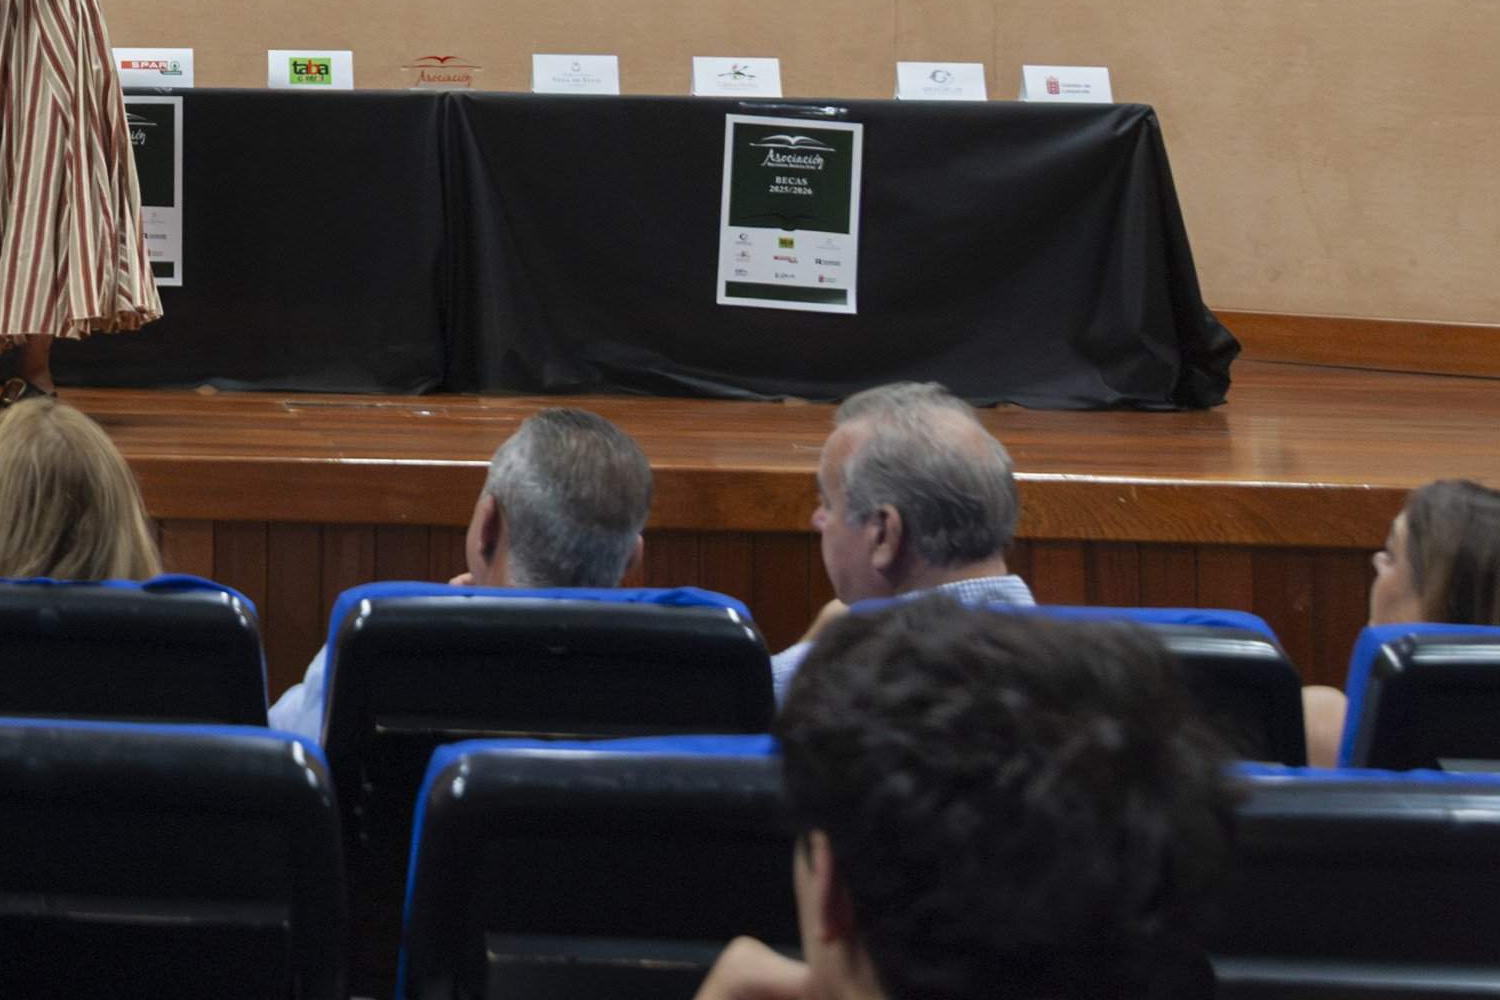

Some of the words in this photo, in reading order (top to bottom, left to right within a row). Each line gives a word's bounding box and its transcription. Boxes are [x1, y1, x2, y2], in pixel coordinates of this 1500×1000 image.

[131, 60, 168, 70] SPAR
[292, 59, 329, 75] taba
[761, 148, 825, 170] Asociación
[775, 176, 808, 185] BECAS
